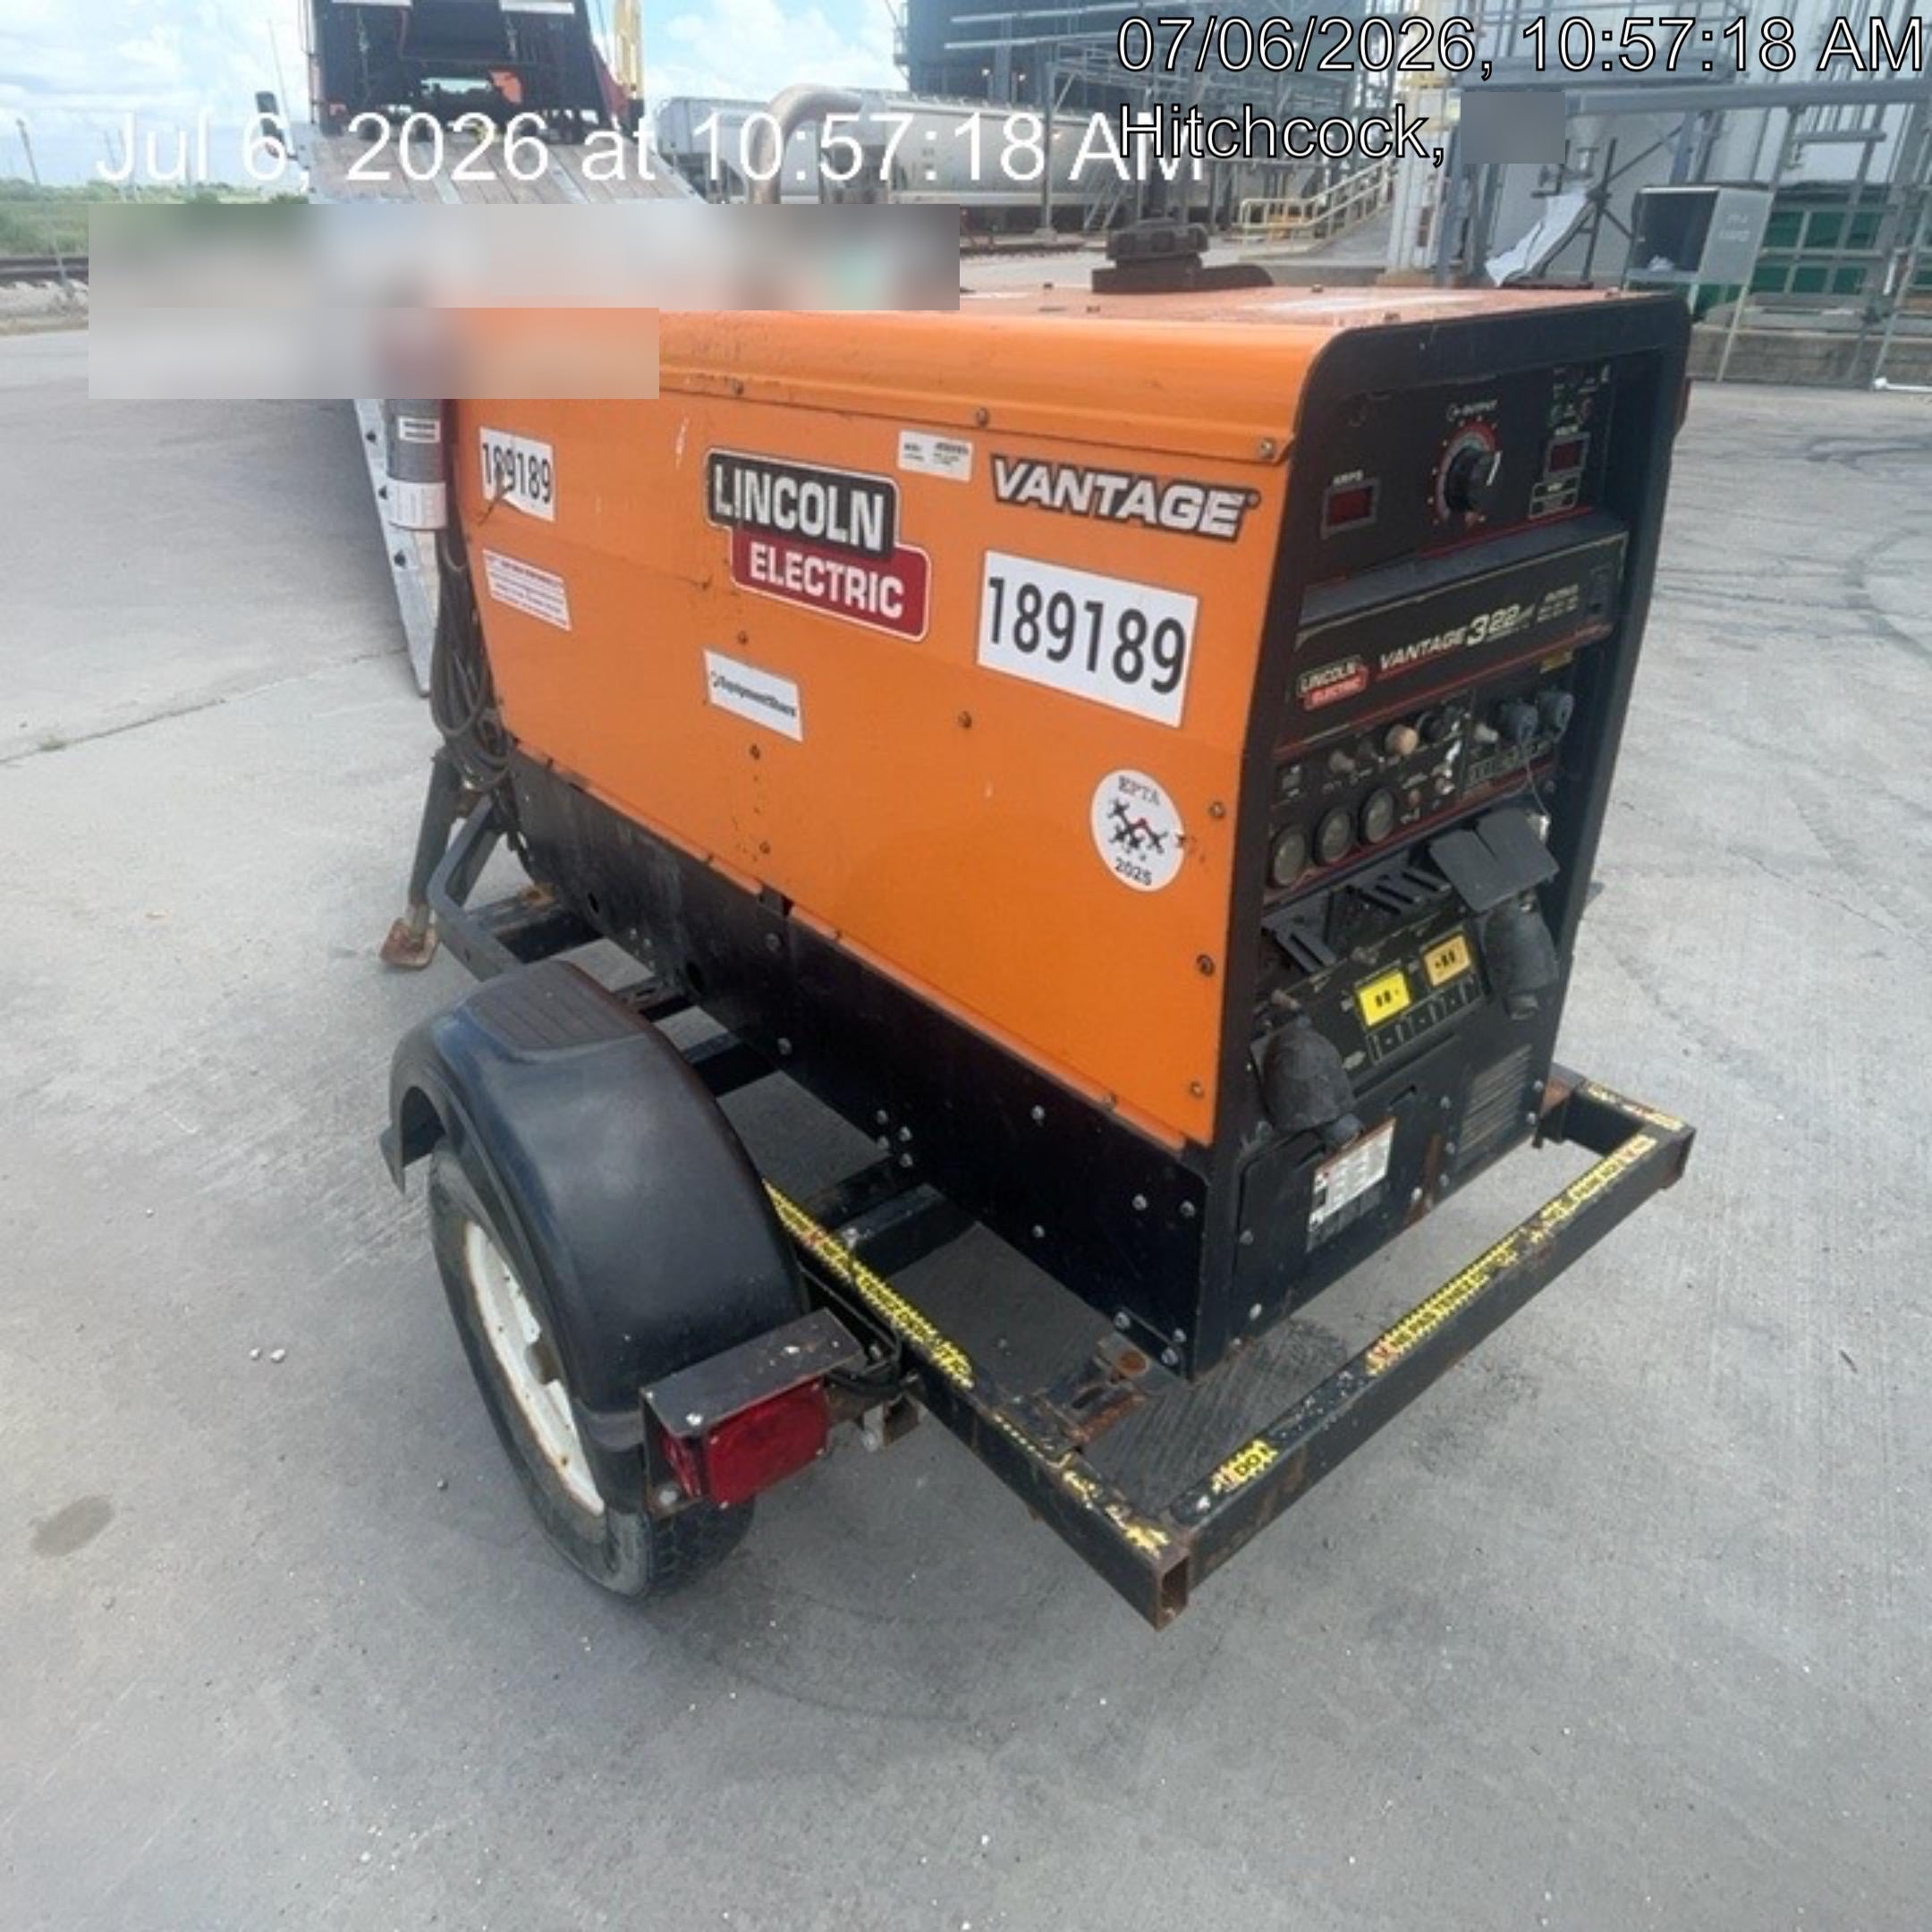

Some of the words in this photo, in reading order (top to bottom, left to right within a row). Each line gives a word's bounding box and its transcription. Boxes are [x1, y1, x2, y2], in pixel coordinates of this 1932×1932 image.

[715, 463, 884, 552] LINCOLN
[993, 457, 1247, 538] VANTAGE
[750, 540, 903, 619] ELECTRIC
[988, 576, 1187, 695] 189189
[1380, 625, 1469, 671] VANTAGE
